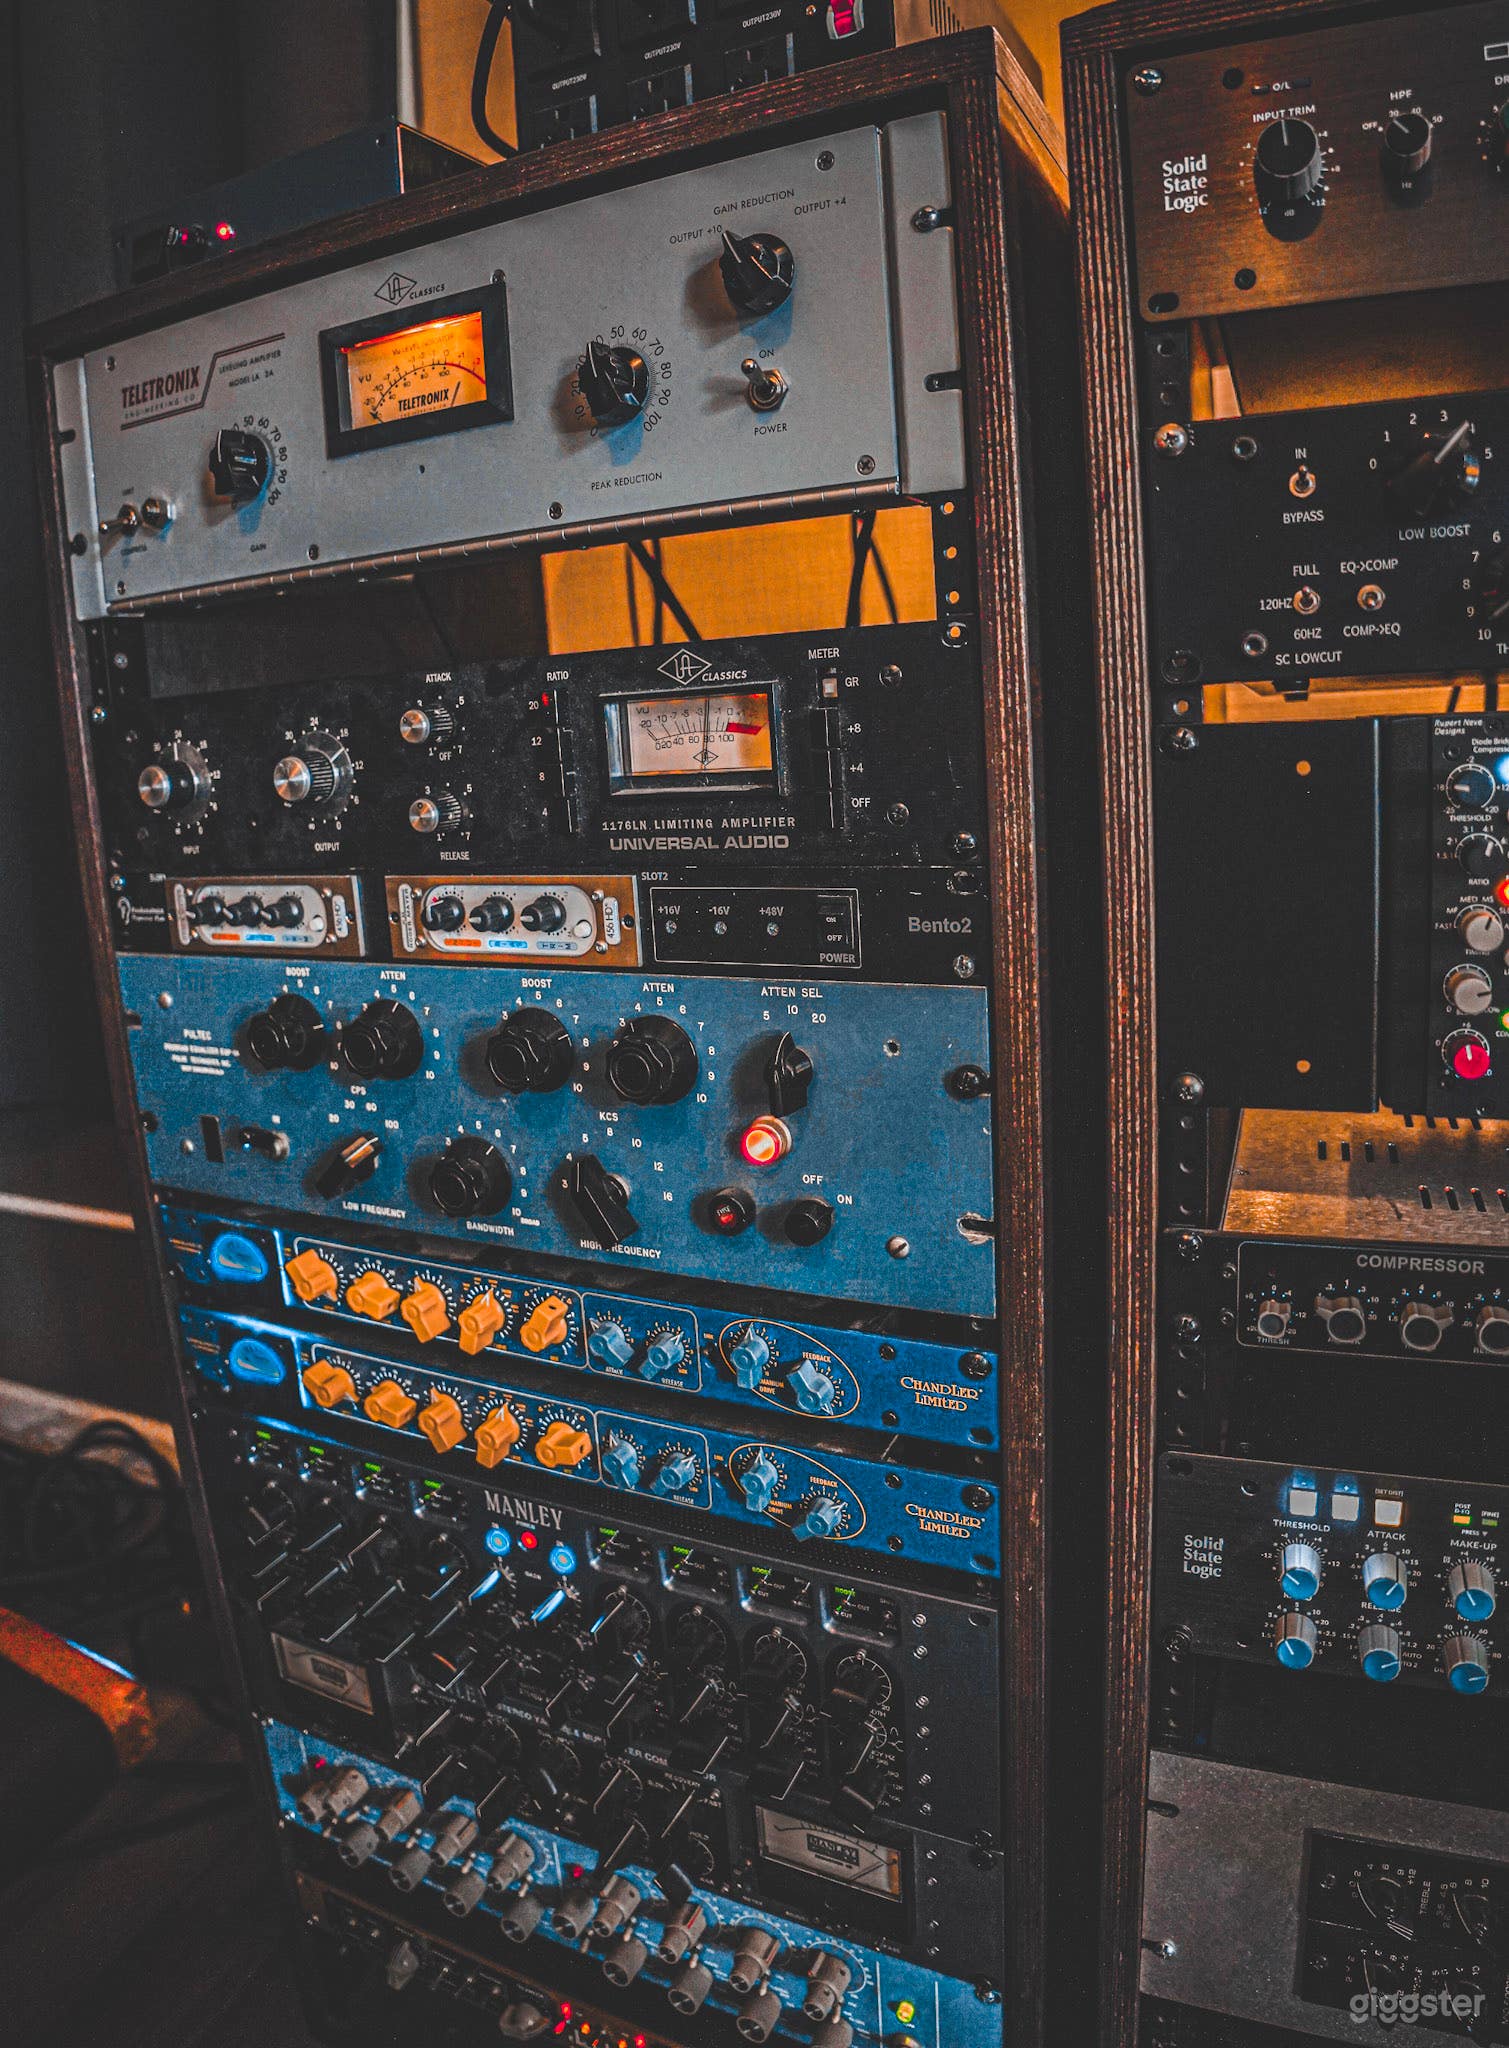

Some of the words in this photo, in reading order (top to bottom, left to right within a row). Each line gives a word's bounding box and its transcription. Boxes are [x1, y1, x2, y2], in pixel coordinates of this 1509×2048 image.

[742, 9, 782, 28] OUTPUT230V
[644, 42, 682, 60] OUTPUT230V
[1272, 81, 1290, 92] O/L
[1390, 89, 1413, 101] HPF
[1252, 110, 1285, 123] INPUT
[1288, 104, 1316, 118] TRIM
[1432, 115, 1443, 124] 50
[1362, 121, 1378, 131] OFF
[1162, 154, 1208, 178] Solid
[1163, 175, 1208, 195] State
[713, 201, 739, 216] GAIN
[741, 189, 795, 210] REDUCTION
[794, 201, 832, 216] OUTPUT
[834, 197, 847, 208] +4
[1164, 193, 1209, 214] Logic
[669, 229, 704, 245] OUTPUT
[706, 224, 723, 236] +10
[409, 284, 445, 299] CLASSICS
[611, 326, 625, 339] 50
[632, 328, 647, 341] 60
[649, 338, 664, 356] 70
[759, 348, 774, 359] ON
[661, 362, 672, 379] 80
[122, 365, 200, 408] TELETRONIX
[228, 376, 250, 388] MODEL
[398, 389, 449, 412] TELETRONIX
[659, 389, 671, 406] 90
[243, 415, 254, 426] 50
[644, 411, 662, 432] 100
[1409, 413, 1417, 425] 2
[1440, 409, 1448, 422] 3
[258, 416, 270, 429] 60
[270, 425, 281, 442] 70
[754, 423, 788, 436] POWER
[278, 446, 288, 462] 80
[1295, 448, 1307, 459] IN
[1484, 447, 1493, 459] 5
[278, 469, 288, 484] 90
[591, 479, 612, 491] PEAK
[613, 471, 662, 488] REDUCTION
[1283, 510, 1324, 524] BYPASS
[1399, 528, 1425, 541] LOW
[1430, 524, 1471, 539] BOOST
[1293, 564, 1320, 577] FULL
[1340, 558, 1399, 574] EQ->COMP
[1259, 598, 1293, 611] 120HZ
[1293, 628, 1322, 640] 60HZ
[1343, 623, 1401, 638] COMP->EQ
[1478, 628, 1492, 641] 10
[808, 648, 840, 660] METER
[1275, 654, 1291, 666] SC
[1294, 651, 1342, 665] LOWCUT
[425, 672, 451, 683] ATTACK
[546, 670, 569, 681] RATIO
[702, 670, 747, 682] CLASSICS
[844, 676, 860, 688] GR
[528, 701, 539, 710] 20
[310, 717, 319, 727] 24
[655, 715, 667, 723] -10
[1434, 719, 1461, 728] Rupert
[1463, 718, 1483, 727] Neve
[847, 723, 862, 733] +8
[1434, 728, 1466, 737] Designs
[531, 737, 542, 747] 12
[719, 734, 734, 742] 100
[1471, 738, 1492, 746] Diode
[439, 752, 452, 761] OFF
[355, 760, 364, 770] 12
[849, 763, 864, 773] +4
[851, 797, 871, 808] OFF
[602, 820, 648, 831] 1176LN
[654, 818, 713, 830] LIMITING
[721, 817, 796, 829] AMPLIFIER
[1449, 814, 1492, 822] THRESHOLD
[314, 842, 340, 851] OUTPUT
[609, 836, 719, 851] UNIVERSAL
[724, 835, 789, 849] AUDIO
[440, 851, 470, 861] RELEASE
[641, 872, 668, 881] SLOT2
[1468, 879, 1490, 887] RATIO
[658, 905, 680, 915] +16V
[708, 905, 730, 915] -16V
[759, 906, 784, 916] +48V
[908, 916, 972, 933] Bento2
[827, 934, 842, 942] OFF
[819, 952, 855, 964] POWER
[286, 967, 310, 977] BOOST
[380, 970, 406, 981] ATTEN
[521, 978, 552, 989] BOOST
[643, 983, 675, 993] ATTEN
[761, 987, 796, 997] ATTEN
[801, 988, 823, 998] SEL
[787, 1005, 798, 1015] 10
[811, 1013, 826, 1024] 20
[426, 1070, 435, 1080] 10
[350, 1085, 366, 1096] CPS
[573, 1083, 583, 1093] 10
[696, 1093, 707, 1103] 10
[599, 1112, 618, 1122] KCS
[385, 1120, 399, 1130] 100
[632, 1138, 642, 1148] 10
[654, 1161, 664, 1172] 12
[802, 1175, 823, 1185] OFF
[663, 1191, 673, 1202] 16
[837, 1195, 852, 1205] ON
[343, 1201, 359, 1212] LOW
[361, 1204, 406, 1219] FREQUENCY
[466, 1221, 514, 1236] BANDWIDTH
[1356, 1253, 1485, 1275] COMPRESSOR
[1370, 1296, 1380, 1304] 10
[802, 1352, 831, 1363] FEEDBACK
[900, 1376, 979, 1400] CHANDLER
[915, 1392, 968, 1412] LIMITED
[810, 1476, 838, 1488] FEEDBACK
[484, 1491, 564, 1531] MANLEY
[905, 1504, 981, 1528] CHANDLER
[919, 1519, 970, 1539] LIMITED
[1273, 1519, 1331, 1532] THRESHOLD
[1367, 1530, 1406, 1541] ATTACK
[1184, 1534, 1224, 1552] Solid
[1450, 1539, 1497, 1551] MAKE-UP
[1183, 1548, 1223, 1565] State
[1183, 1562, 1222, 1580] Logic
[1419, 1880, 1432, 1915] TREBLE
